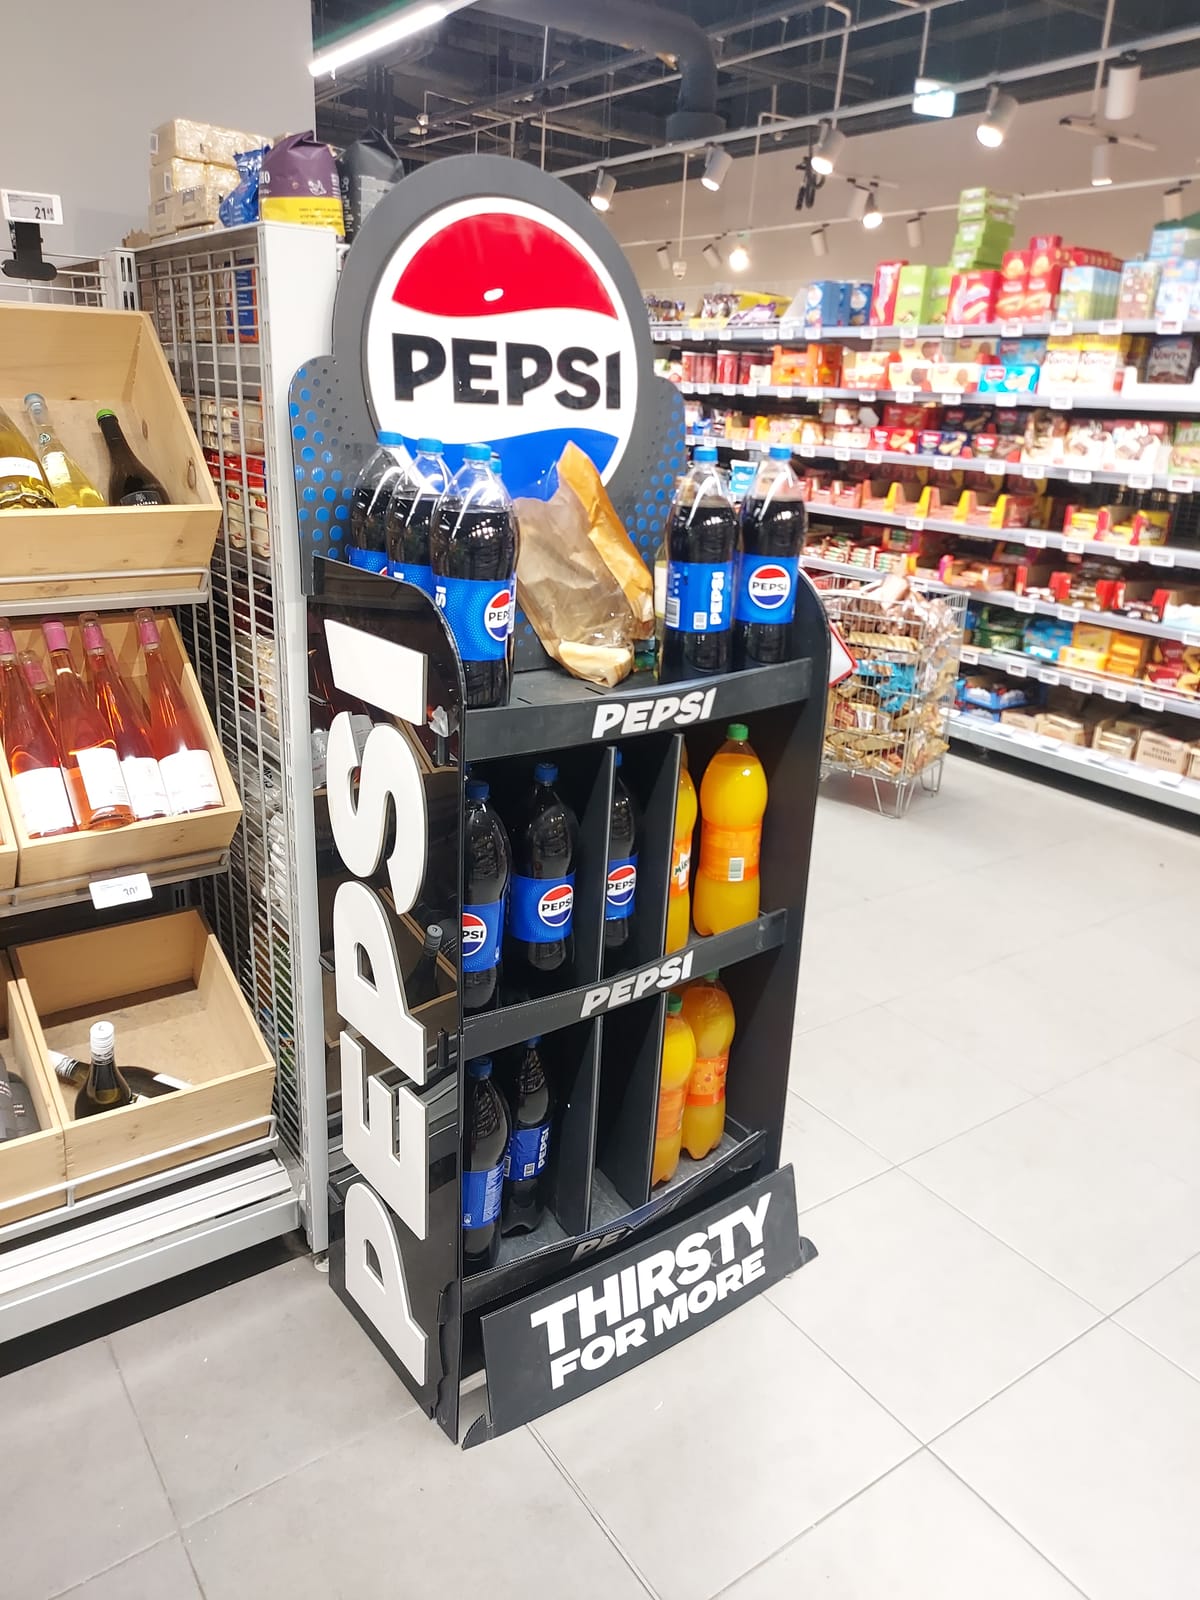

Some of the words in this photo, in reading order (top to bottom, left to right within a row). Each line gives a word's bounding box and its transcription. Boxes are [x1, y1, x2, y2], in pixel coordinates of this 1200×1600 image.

[392, 333, 621, 410] PEPSI
[710, 572, 725, 625] PEPSI
[752, 581, 787, 591] PEPSI
[591, 687, 718, 739] PEPSI
[607, 879, 635, 891] PEPS
[462, 930, 484, 940] PSI
[323, 619, 428, 1387] PEPSI
[580, 950, 694, 1018] PEPSI
[537, 1127, 550, 1169] PEPSI
[530, 1192, 772, 1355] THIRSTY
[550, 1318, 648, 1390] FOR
[652, 1248, 766, 1337] MORE
